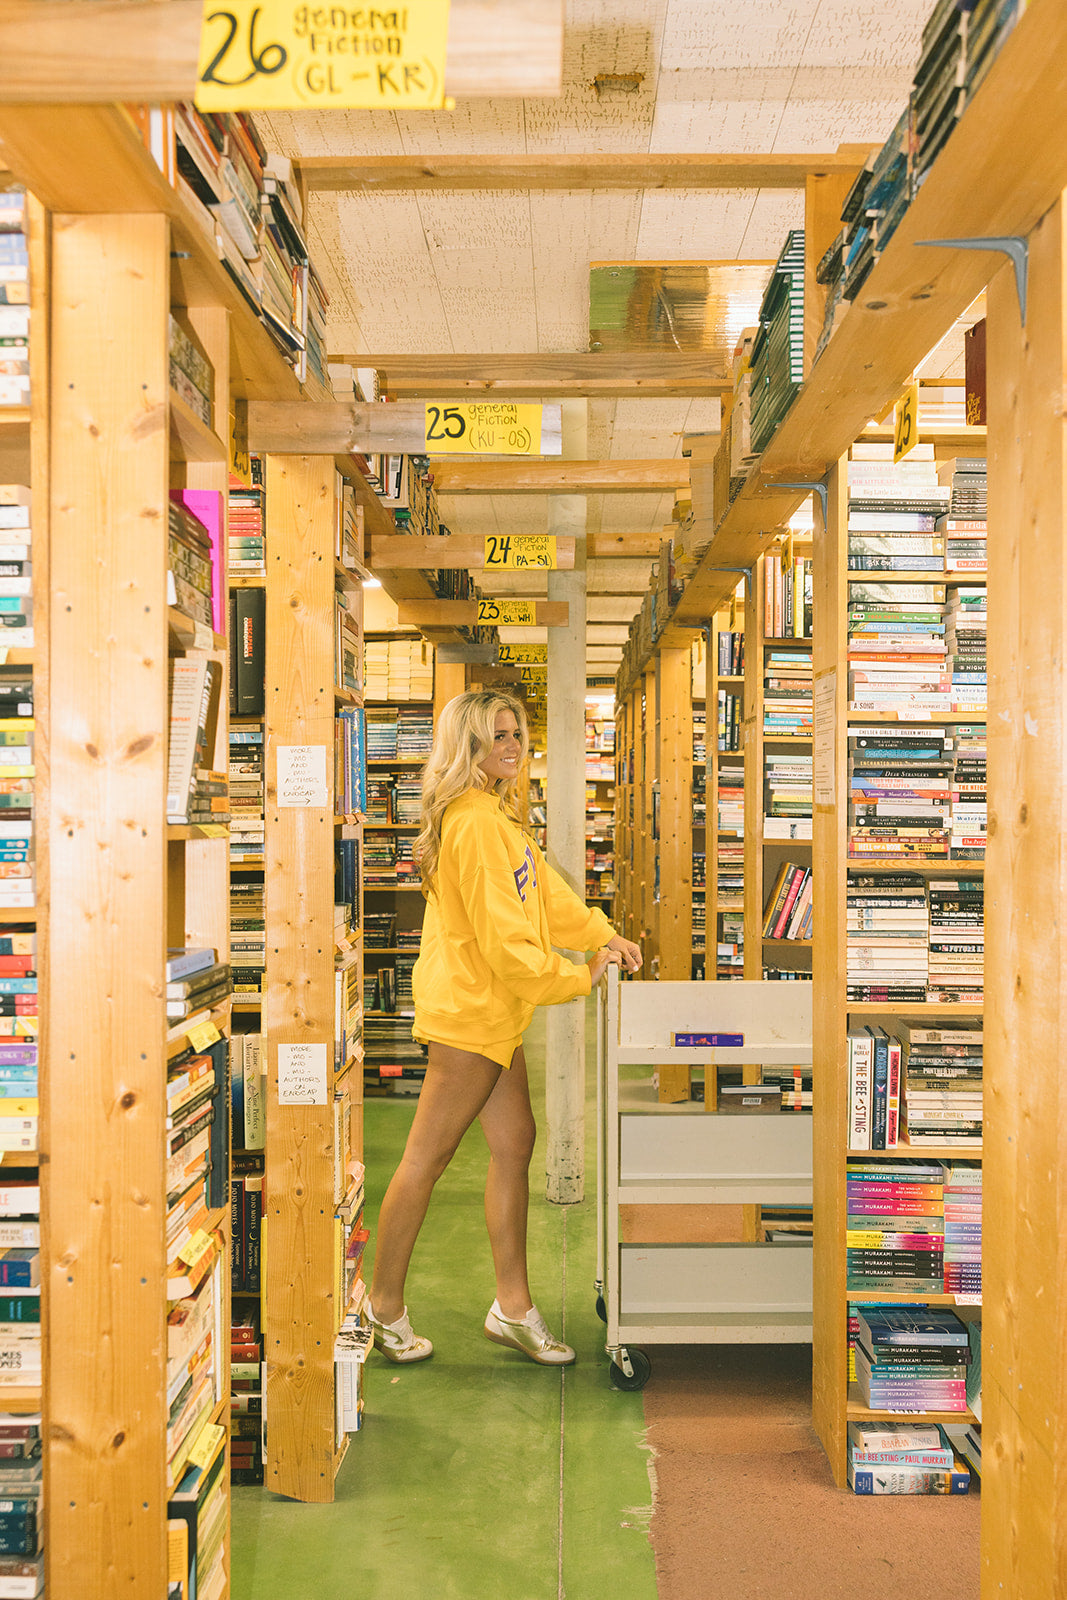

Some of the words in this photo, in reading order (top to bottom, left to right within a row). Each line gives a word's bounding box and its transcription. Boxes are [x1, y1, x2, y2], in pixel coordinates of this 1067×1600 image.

[201, 8, 288, 86] 26
[426, 406, 466, 441] 25
[487, 536, 512, 564] 24
[478, 601, 500, 620] 23
[498, 646, 515, 660] 22
[522, 667, 533, 680] 21
[856, 1060, 868, 1078] THE
[856, 1081, 867, 1096] BEE
[855, 1105, 867, 1133] STING
[867, 1453, 878, 1461] BEE
[881, 1454, 899, 1463] STING
[905, 1455, 920, 1464] PAUL
[922, 1456, 947, 1465] MURRAY
